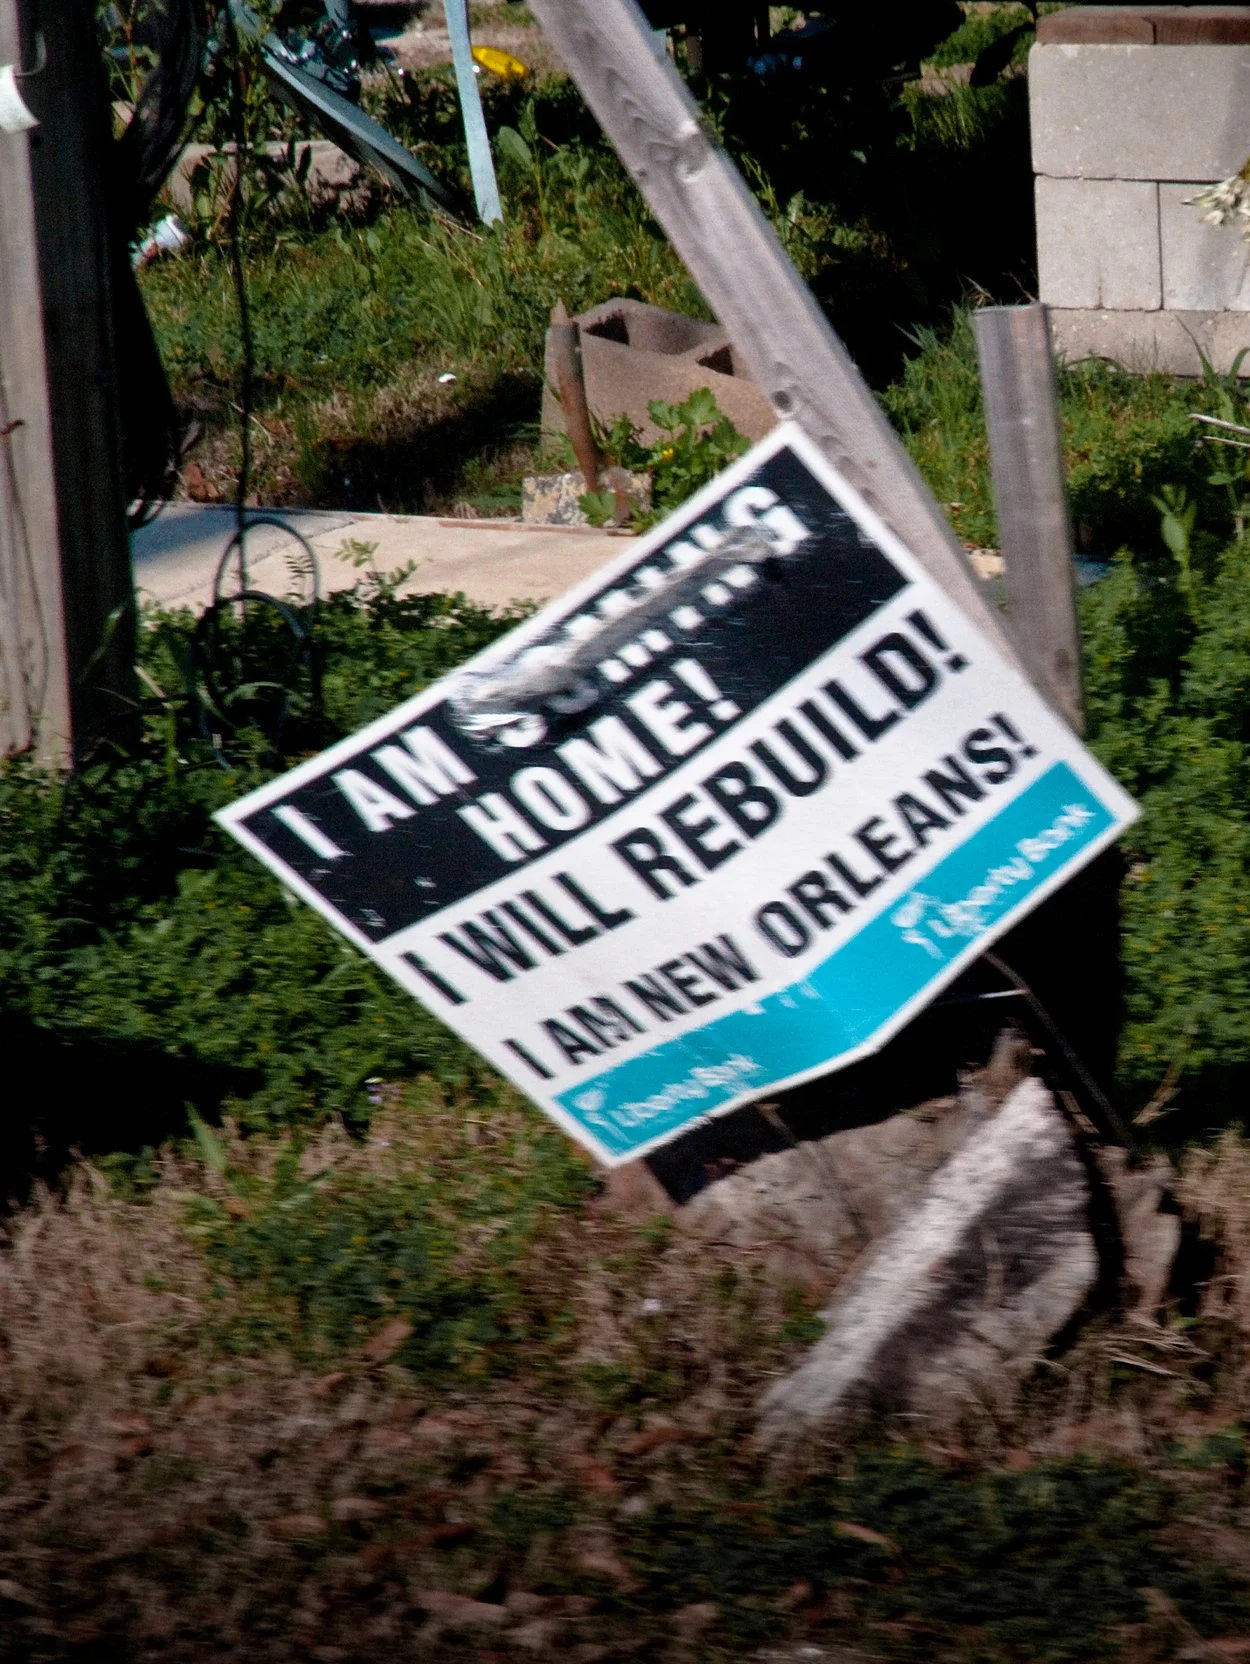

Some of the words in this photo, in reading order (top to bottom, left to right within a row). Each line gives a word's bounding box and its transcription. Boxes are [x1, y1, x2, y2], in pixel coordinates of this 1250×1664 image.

[270, 804, 346, 860] I
[330, 726, 478, 832] AM
[398, 951, 469, 1005] I
[436, 872, 638, 983] WILL
[610, 608, 971, 901] REBUILD!
[456, 658, 742, 862] HOME!
[502, 1038, 555, 1080] I
[539, 996, 649, 1066] AM
[621, 933, 761, 1021] NEW
[753, 712, 1040, 958] ORLEANS!
